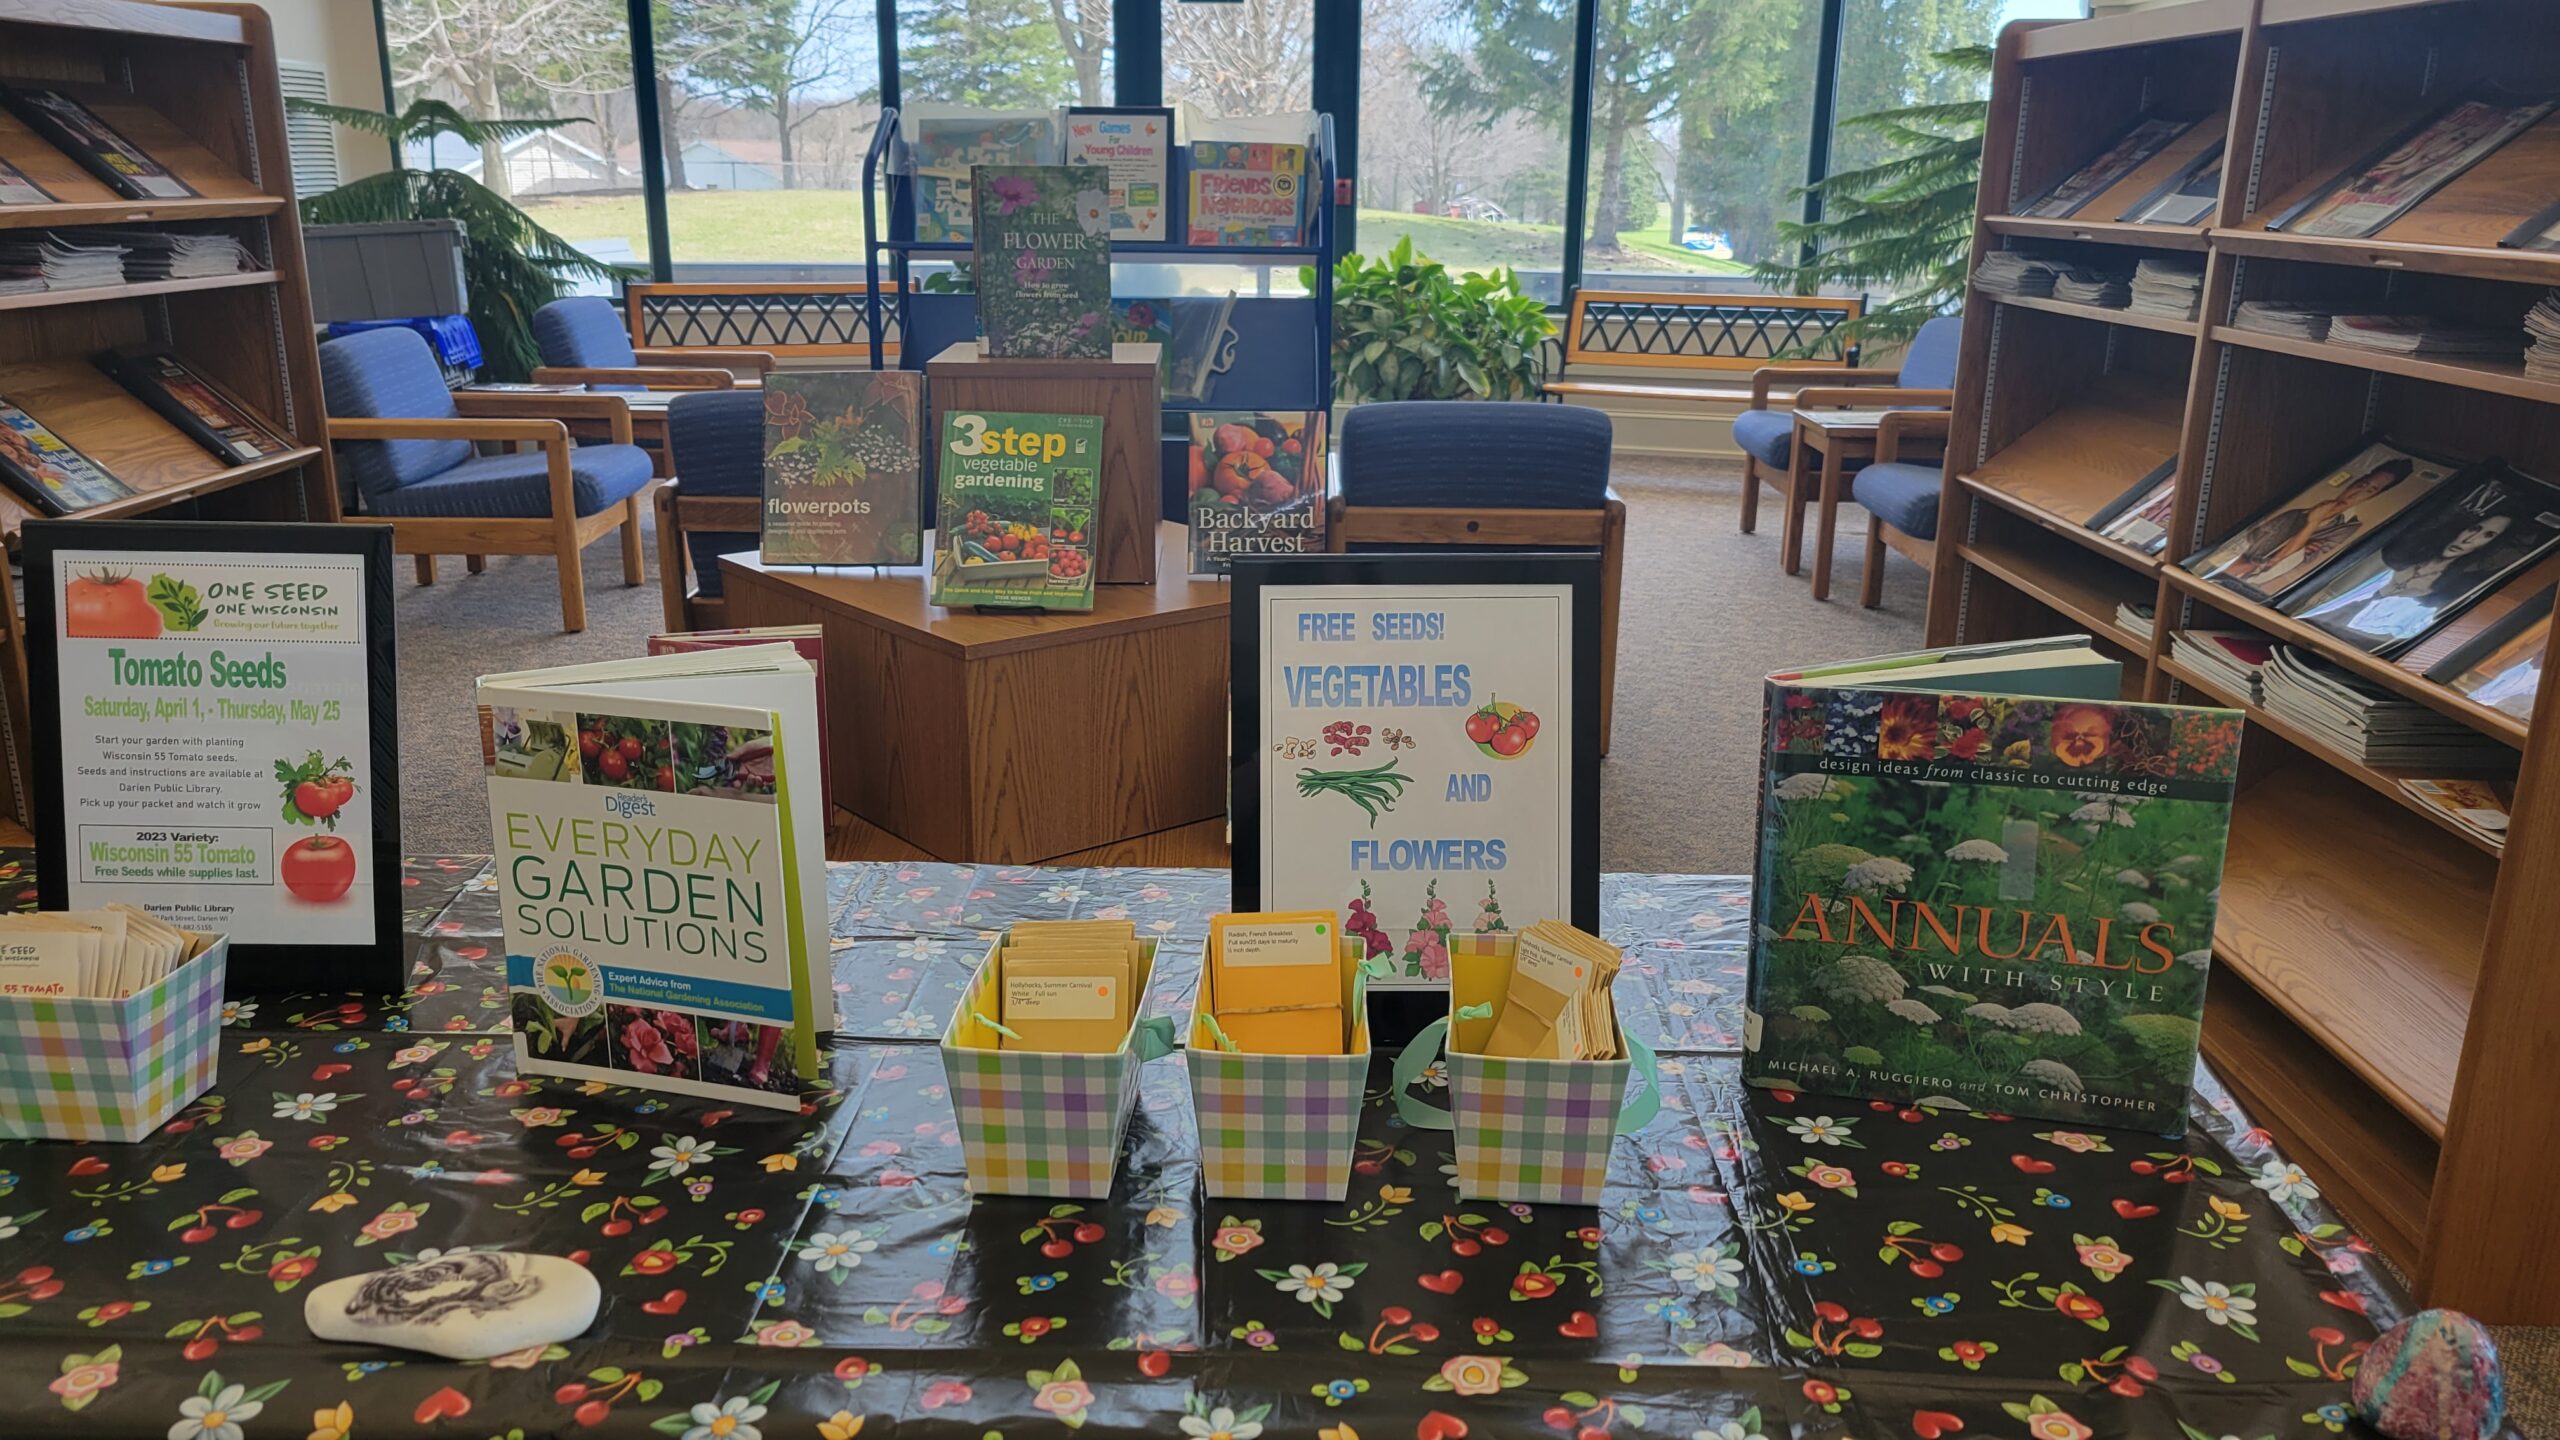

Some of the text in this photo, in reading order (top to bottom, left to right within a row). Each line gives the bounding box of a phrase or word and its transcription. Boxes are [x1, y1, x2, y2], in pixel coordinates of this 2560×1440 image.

[1072, 120, 1132, 137] New Games
[1084, 144, 1153, 157] Young Children
[1030, 212, 1060, 225] THE
[1003, 232, 1087, 250] FLOWER
[1016, 257, 1075, 270] GARDEN
[1015, 290, 1079, 299] flowers from seed
[1024, 281, 1040, 289] How
[1051, 283, 1069, 291] grow
[963, 458, 1038, 473] vegetable
[954, 474, 1044, 492] gardening
[768, 498, 871, 517] flowerpots
[1198, 506, 1316, 533] Backyard
[1208, 531, 1305, 553] Harvest
[208, 582, 328, 601] ONE SEED
[215, 603, 338, 616] ONE WISCONSIN
[214, 619, 339, 633] Growing our future together
[1298, 612, 1445, 641] FREE SEEDS!
[108, 648, 287, 689] Tomato Seeds
[1283, 664, 1472, 708] VEGETABLES
[84, 695, 150, 722] Saturday,
[155, 697, 187, 723] April
[192, 698, 204, 720] 1,
[218, 698, 286, 725] Thursday,
[290, 700, 318, 725] May
[323, 700, 340, 720] 25
[95, 736, 244, 748] Start your garden with planting
[103, 752, 238, 763] Wisconsin 55 Tomato seeds.
[78, 767, 264, 778] Seeds and instructions are available at
[1819, 757, 2168, 795] design ideas from classic to cutting edge
[119, 783, 223, 795] Darien Public Library.
[1445, 773, 1492, 802] AND
[80, 798, 261, 812] Pick up your packet and watch it grow
[617, 792, 648, 804] Reader's
[605, 796, 656, 819] Digest
[136, 831, 219, 844] 2023 Variety:
[506, 812, 761, 874] EVERYDAY
[89, 842, 256, 864] Wisconsin 55 Tomato
[1351, 839, 1507, 871] FLOWERS
[95, 866, 259, 880] Free Seeds while supplies last.
[512, 855, 764, 927] GARDEN
[144, 903, 234, 914] Darien Public Library
[518, 904, 767, 963] SOLUTIONS
[1780, 892, 2177, 974] ANNUALS
[10, 946, 36, 955] SEED
[537, 945, 570, 967] NATIONAL
[573, 948, 601, 994] GARDENING
[4, 982, 64, 996] 55 TOMATO
[608, 972, 692, 990] Expert Advice from
[1927, 962, 2165, 1003] WITH STYLE
[546, 993, 596, 1015] ASSOCIATION
[610, 983, 765, 1012] The National Gardening Association
[1768, 1060, 2157, 1112] MICHAEL A. RUGGIERO and TOM CHRISTOPHER
